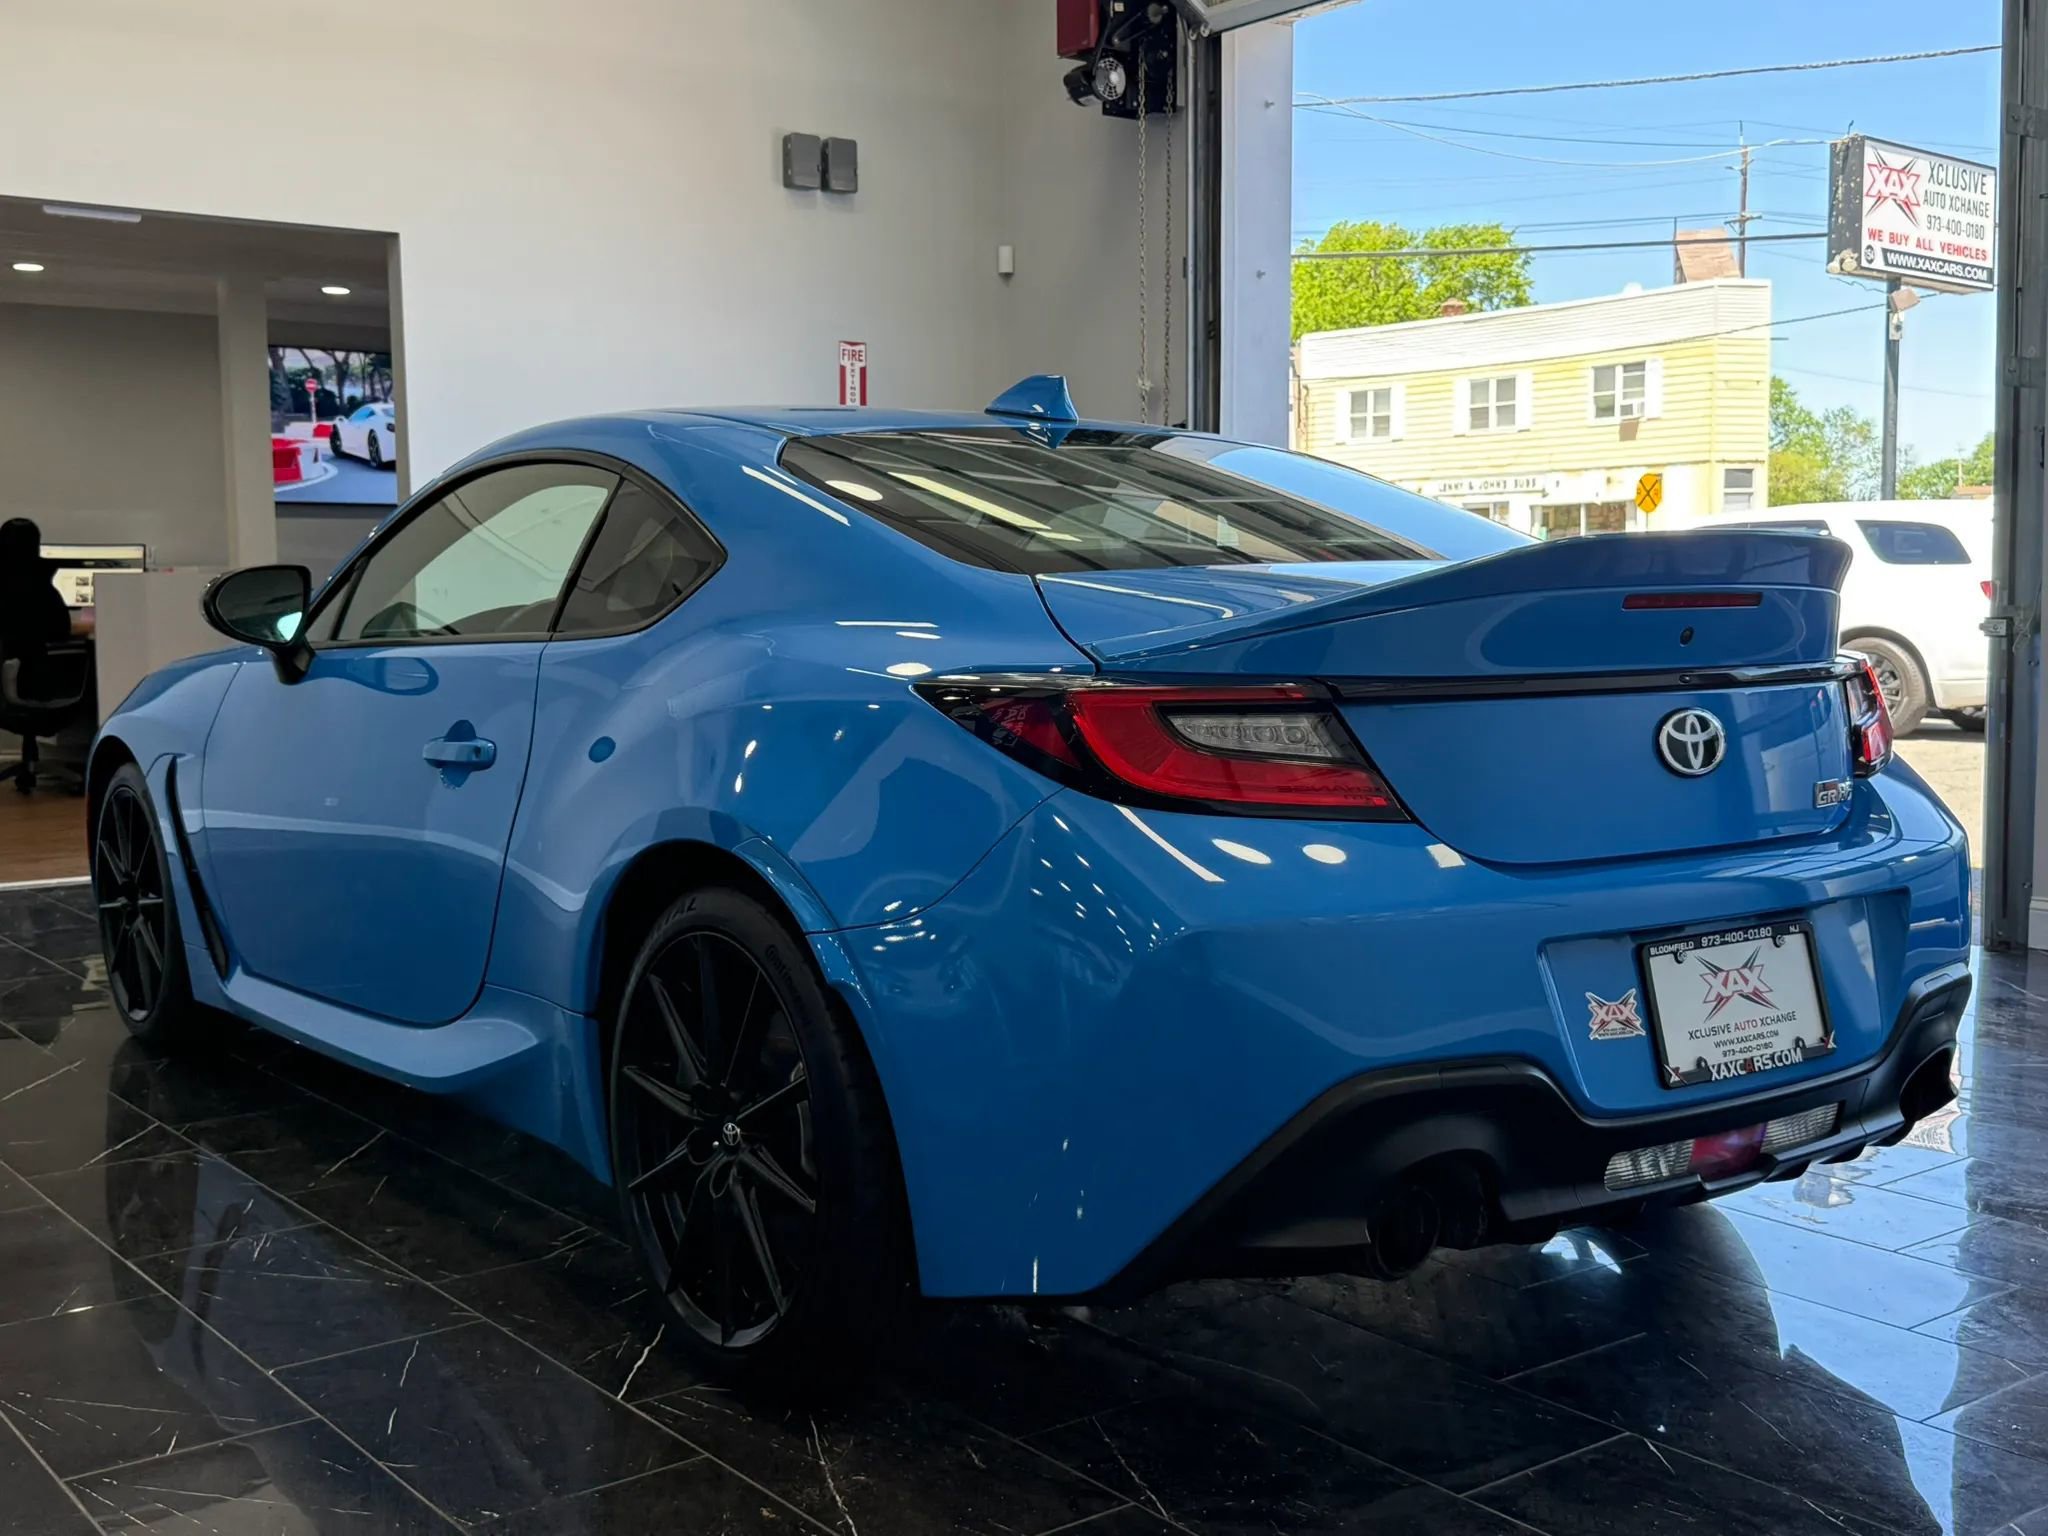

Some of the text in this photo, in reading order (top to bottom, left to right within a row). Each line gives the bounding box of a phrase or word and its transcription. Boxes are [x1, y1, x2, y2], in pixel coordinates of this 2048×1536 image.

[1865, 163, 1920, 207] XAX
[1928, 161, 1987, 195] XCLUSIVE
[1923, 190, 1990, 218] AUTO XCHANGE
[1926, 215, 1985, 240] 973-400-0180
[1867, 228, 1988, 261] WE BUY ALL VEHICLES
[1887, 252, 1988, 280] WWW.XAXCARS.COM
[842, 348, 864, 362] FIRE
[1649, 924, 1800, 955] BLOOMFIELD 973-400-0180 NJ
[1700, 964, 1773, 1003] XAX
[1591, 1003, 1641, 1025] XAX
[1688, 1011, 1797, 1040] XCLUSIVE AUTO XCHANGE
[1713, 1029, 1779, 1049] WWW.XAXCARS.COM
[1722, 1041, 1774, 1057] 973-400-0180
[1709, 1047, 1803, 1081] XAXCARS.COM
